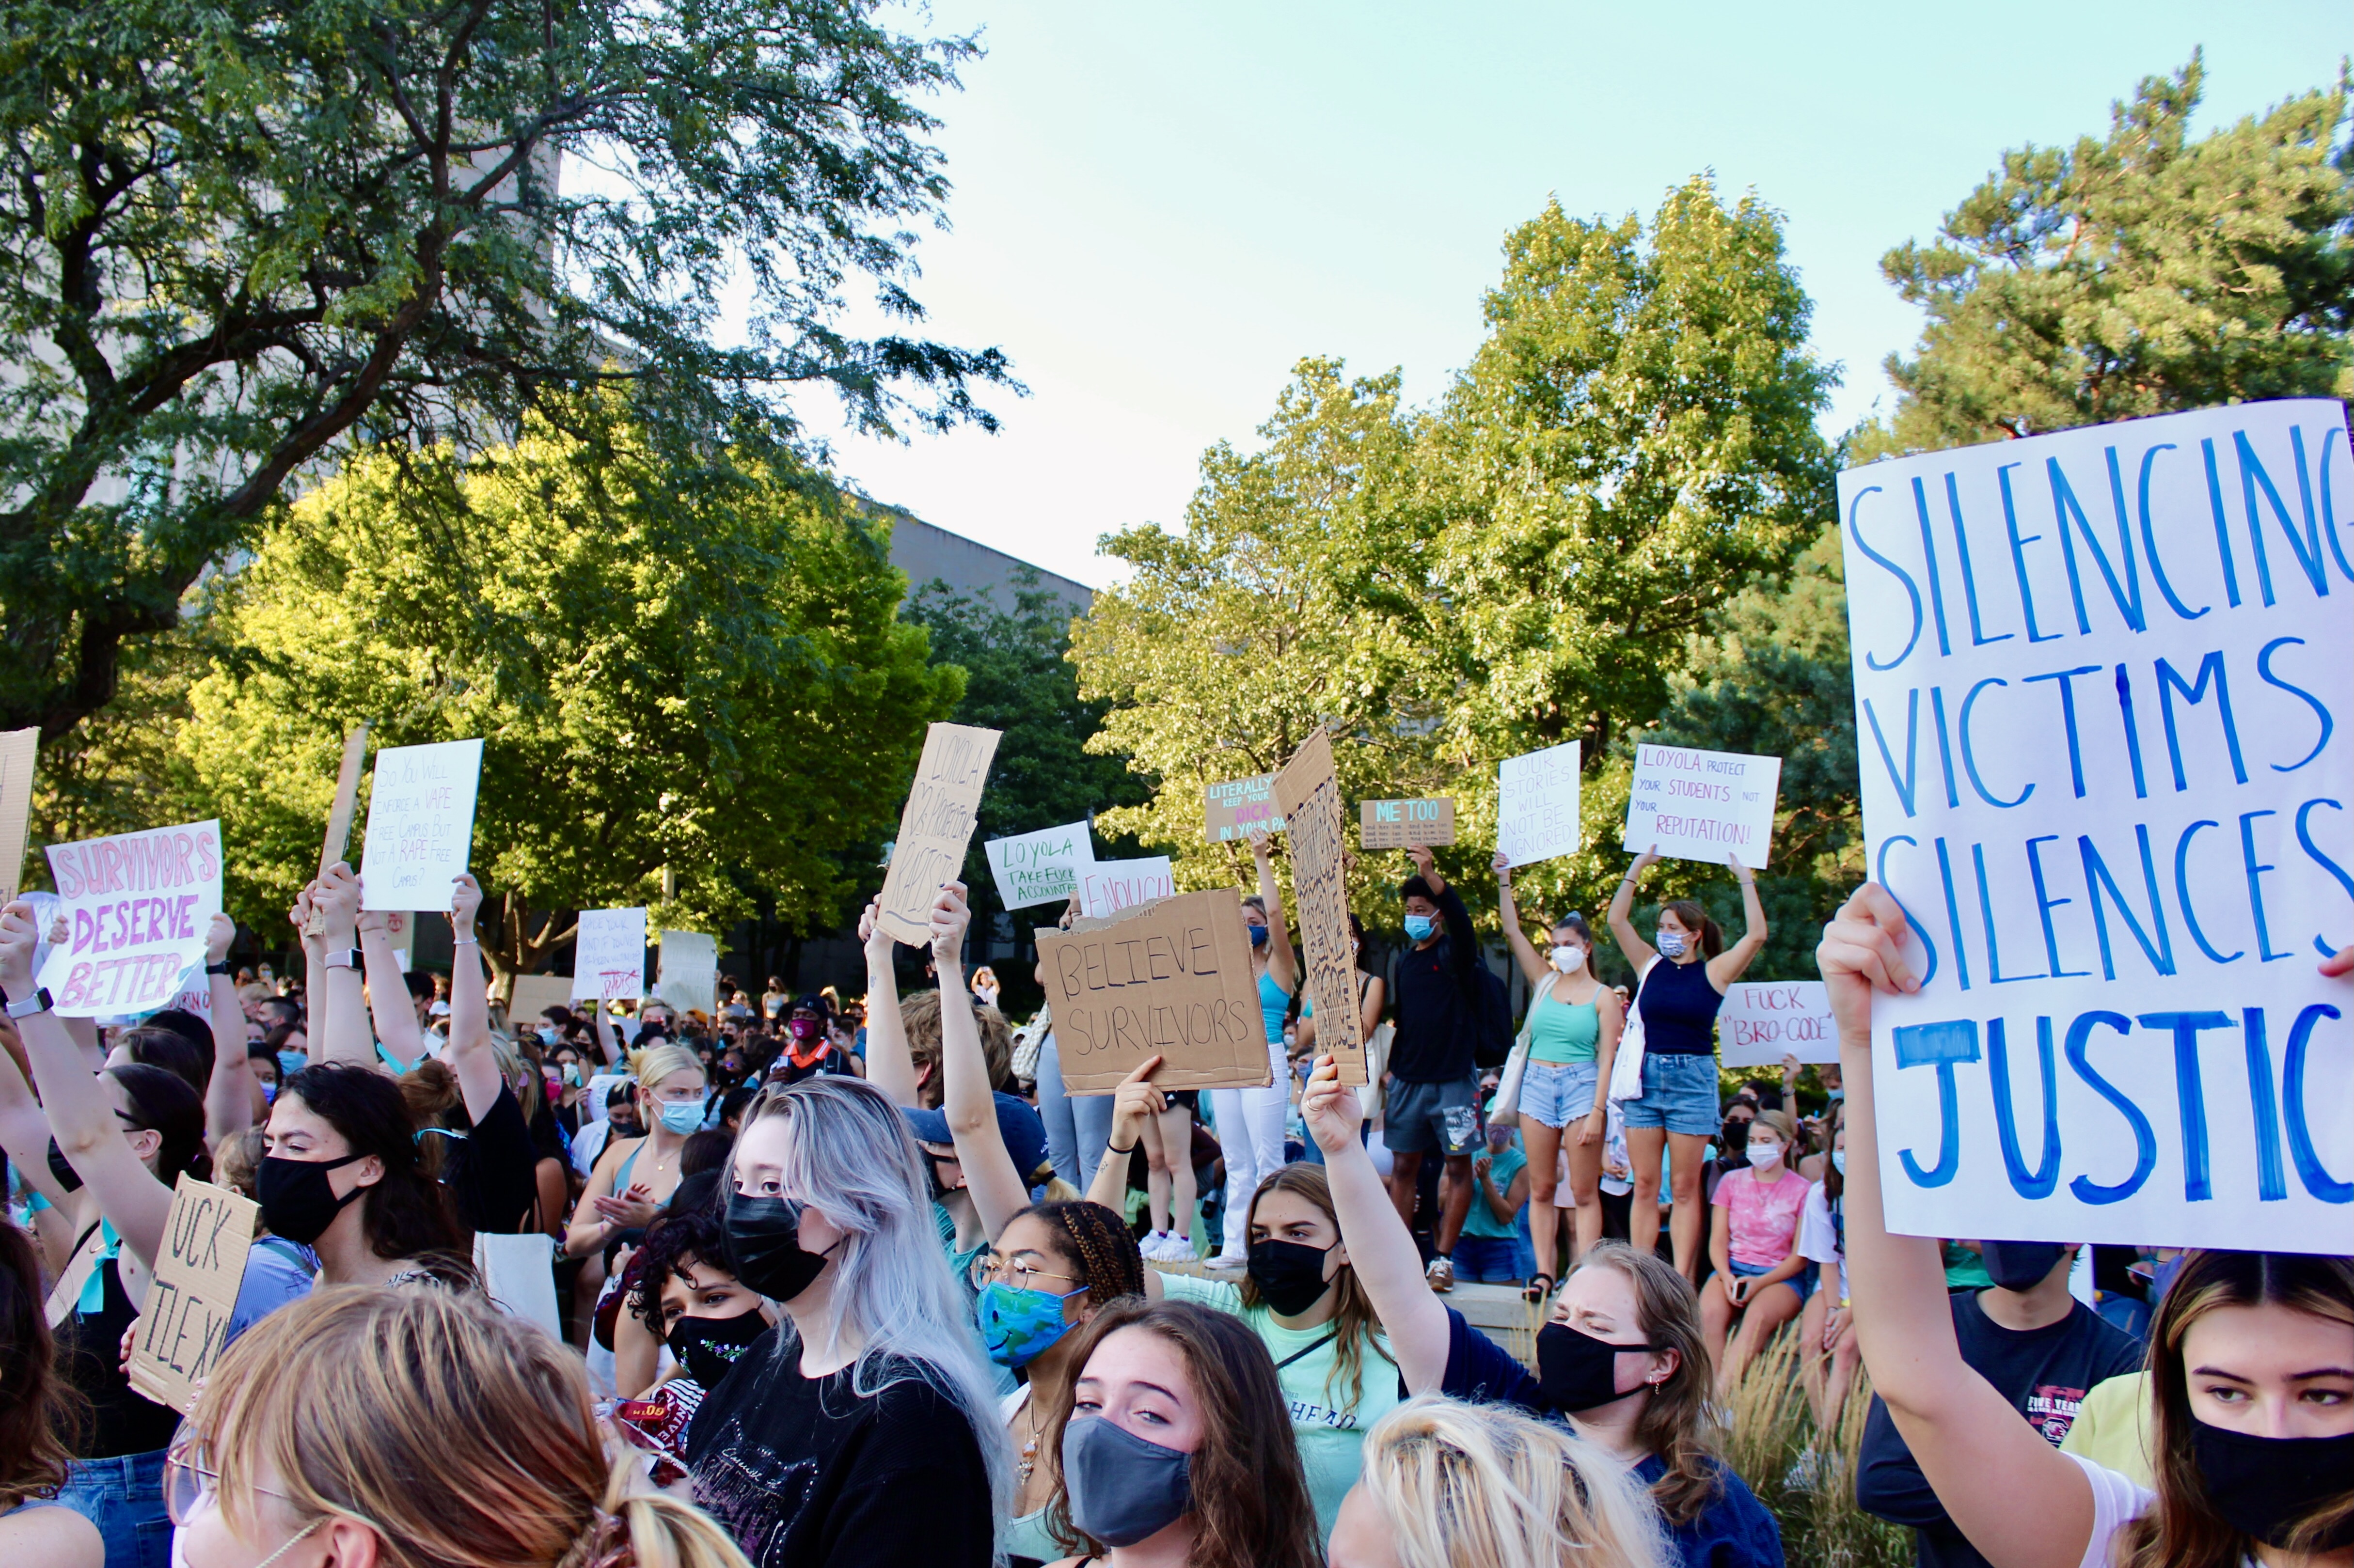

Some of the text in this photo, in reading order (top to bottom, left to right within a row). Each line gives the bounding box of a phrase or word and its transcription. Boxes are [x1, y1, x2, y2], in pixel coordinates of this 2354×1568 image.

[1862, 637, 2333, 818] VICTIMS
[379, 752, 448, 787] SO YOU WILL
[932, 735, 983, 789] LOYOLA
[1518, 752, 1554, 776] OUR
[1643, 749, 1746, 775] LOYOLA PROTECT
[1210, 776, 1273, 799] LITERALLY
[1504, 766, 1569, 798] STORIES
[1639, 779, 1760, 802] YOUR STUDENTS NOT
[375, 787, 452, 815] ENFORCE A VAPE
[1223, 791, 1269, 808] KEEP YOUR
[1236, 803, 1272, 823] DICK
[1376, 800, 1439, 822] ME TOO
[1518, 793, 1552, 812] WILL
[1635, 800, 1658, 812] YOUR
[372, 814, 452, 841] FREE CAMPUS BUT
[925, 787, 974, 844] PROTECTING
[1220, 826, 1232, 840] IN
[1272, 817, 1286, 831] PA
[1505, 804, 1564, 837] NOT BE
[1656, 814, 1751, 845] REPUTATION!
[368, 839, 452, 866] NOT A RAPE FREE
[1004, 838, 1073, 868] LOYOLA
[1511, 825, 1571, 858] IGNORED
[56, 831, 217, 900] SURVIVORS
[392, 866, 425, 889] CAMPUS?
[1005, 867, 1076, 885] TAKE FUCK
[1018, 883, 1078, 900] ACCOUNTAB
[1877, 798, 2354, 991] SILENCES
[70, 894, 199, 957] DESERVE
[1056, 927, 1217, 1002] BELIEVE
[1745, 986, 1805, 1010] FUCK
[1069, 999, 1248, 1055] SURVIVORS
[1892, 1004, 2354, 1205] JUSTIC
[172, 1198, 232, 1272] UCK
[1290, 1401, 1357, 1429] HEAD
